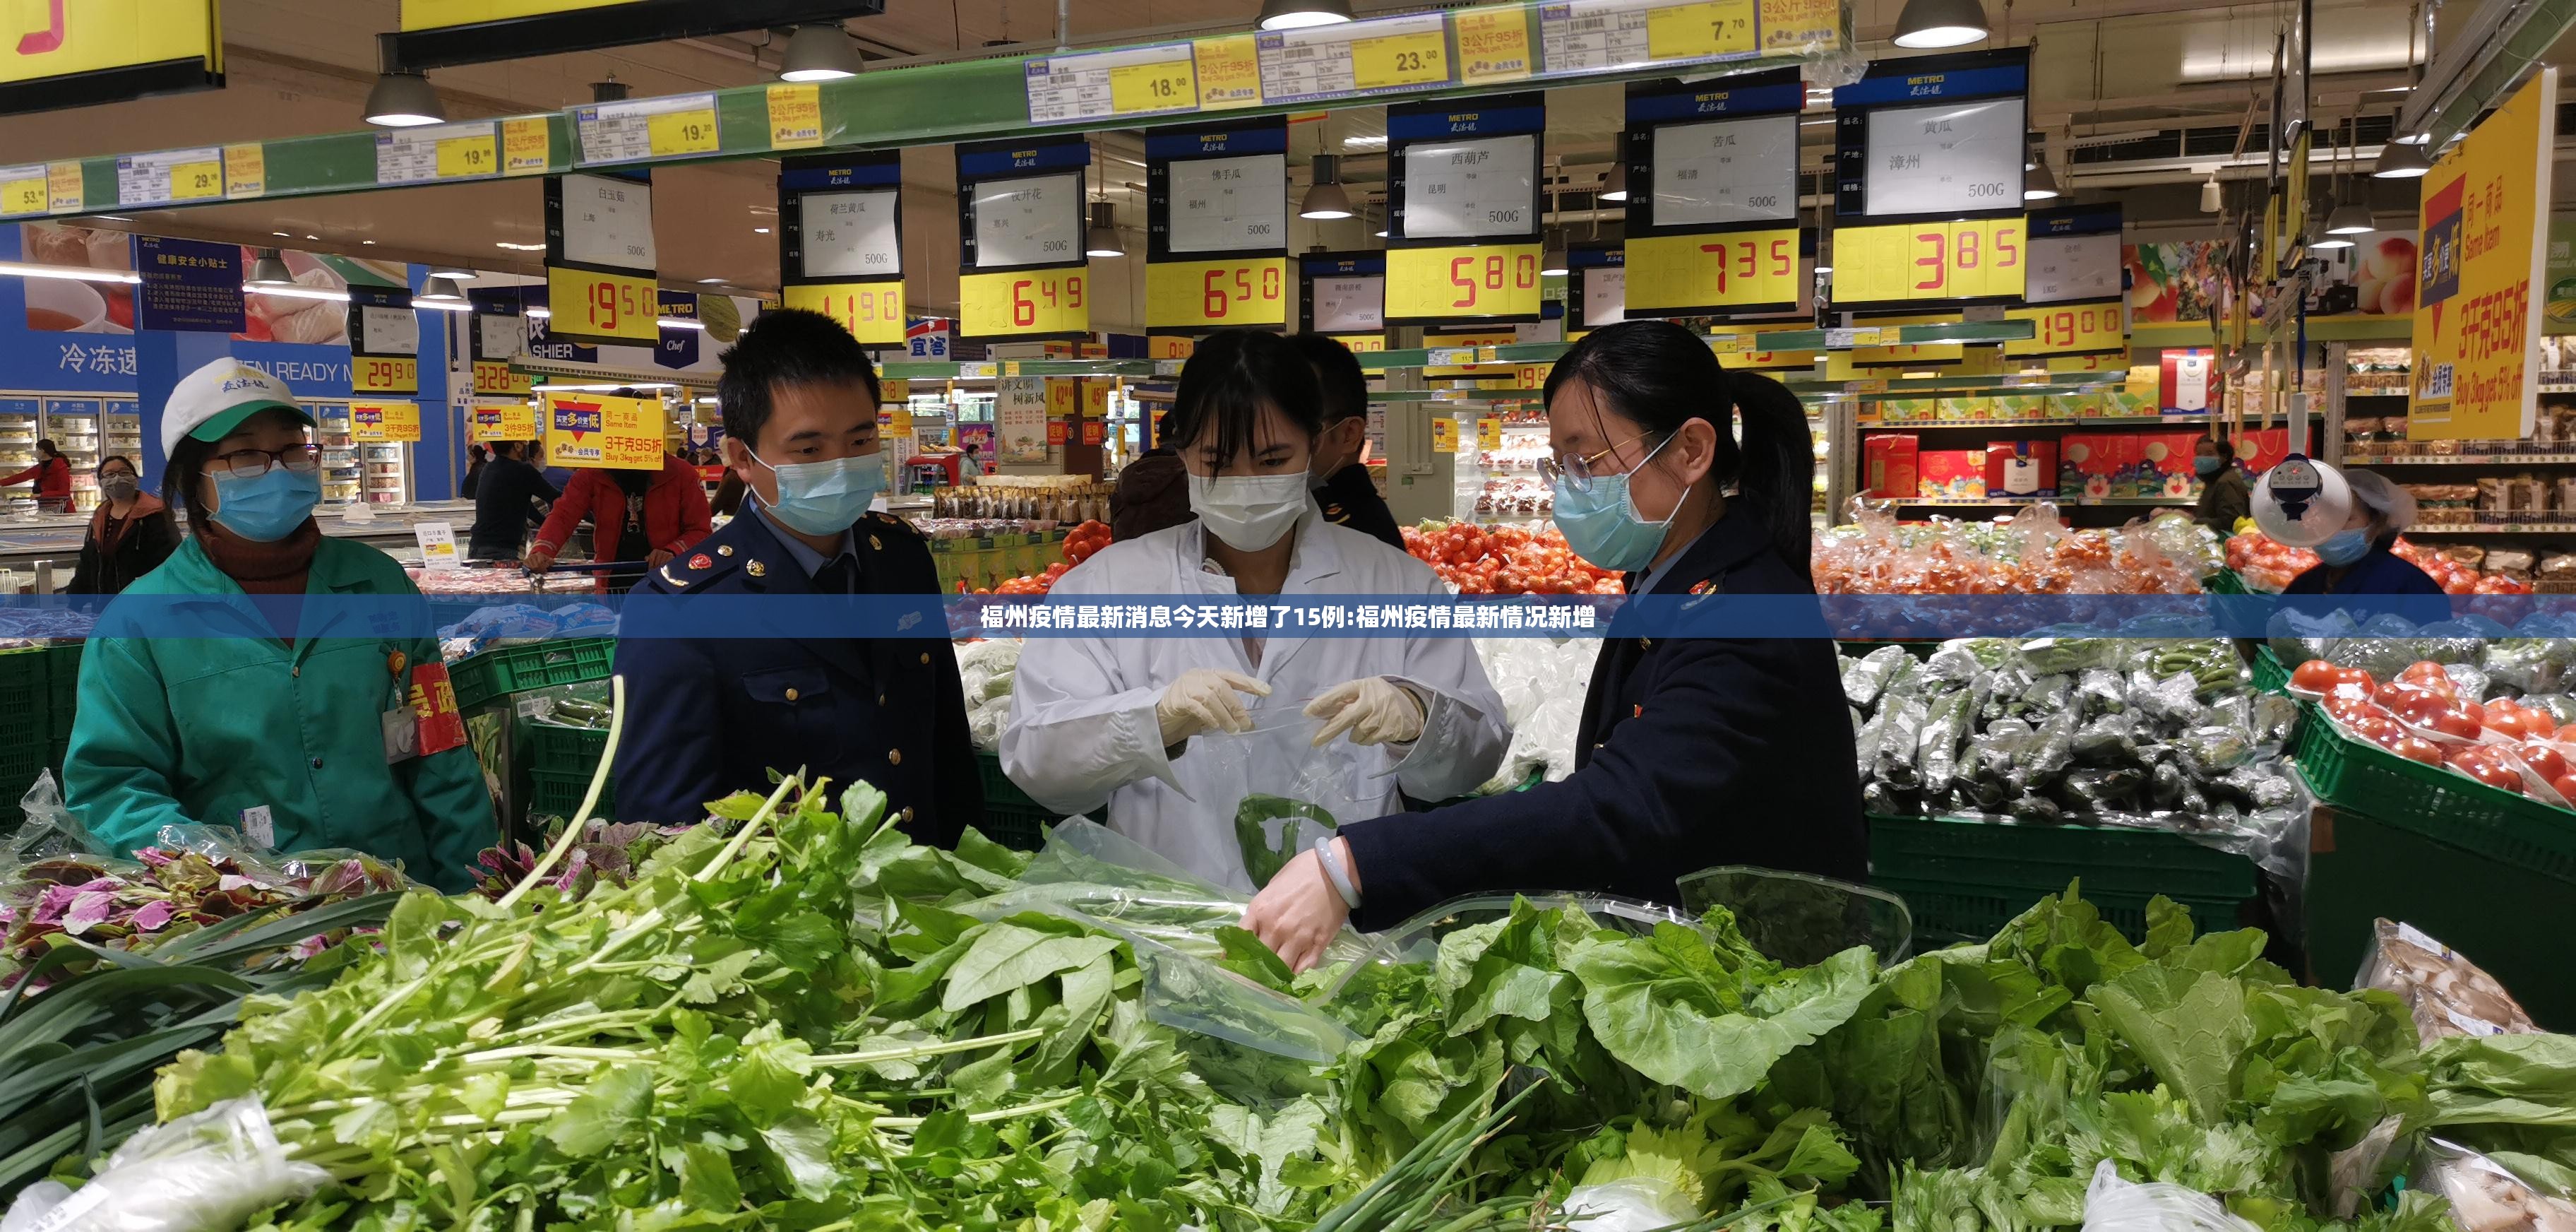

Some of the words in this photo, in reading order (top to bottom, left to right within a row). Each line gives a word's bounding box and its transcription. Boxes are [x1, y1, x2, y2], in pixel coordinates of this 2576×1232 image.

[1908, 75, 1944, 85] METRO
[1695, 92, 1729, 102] METRO
[1449, 113, 1478, 122] METRO
[1924, 120, 1952, 135] 黄瓜
[1712, 135, 1736, 148] 苦瓜
[1012, 150, 1037, 158] METRO
[1452, 151, 1489, 165] 西葫芦
[1890, 154, 1920, 170] 漳州
[1212, 169, 1241, 181] 佛手瓜
[599, 187, 625, 202] 白玉菇
[1428, 184, 1446, 194] 昆明
[1968, 183, 2005, 198] 500G
[830, 202, 865, 214] 荷兰黄瓜
[1189, 199, 1206, 210] 福州
[1748, 196, 1776, 208] 500G
[1489, 211, 1518, 223] 500G
[816, 229, 835, 242] 寿光
[1248, 225, 1270, 235] 500G
[627, 245, 645, 256] 500G
[1044, 240, 1067, 251] 500G
[2465, 232, 2483, 261] Same
[157, 254, 227, 268] 健康安全小贴士
[866, 253, 888, 264] 500G
[657, 304, 693, 314] METRO
[2459, 277, 2529, 362] 3千克95折
[667, 340, 684, 353] Chef
[278, 361, 338, 381] READY
[1001, 379, 1034, 391] 讲文明
[1013, 393, 1045, 405] 树新风
[2456, 374, 2470, 413] Buy
[505, 423, 533, 432] 3件95折
[606, 437, 662, 454] 3千克95折
[578, 448, 600, 456] 会员专享
[606, 453, 618, 461] Buy
[620, 454, 633, 463] 3kg
[634, 455, 643, 463] get
